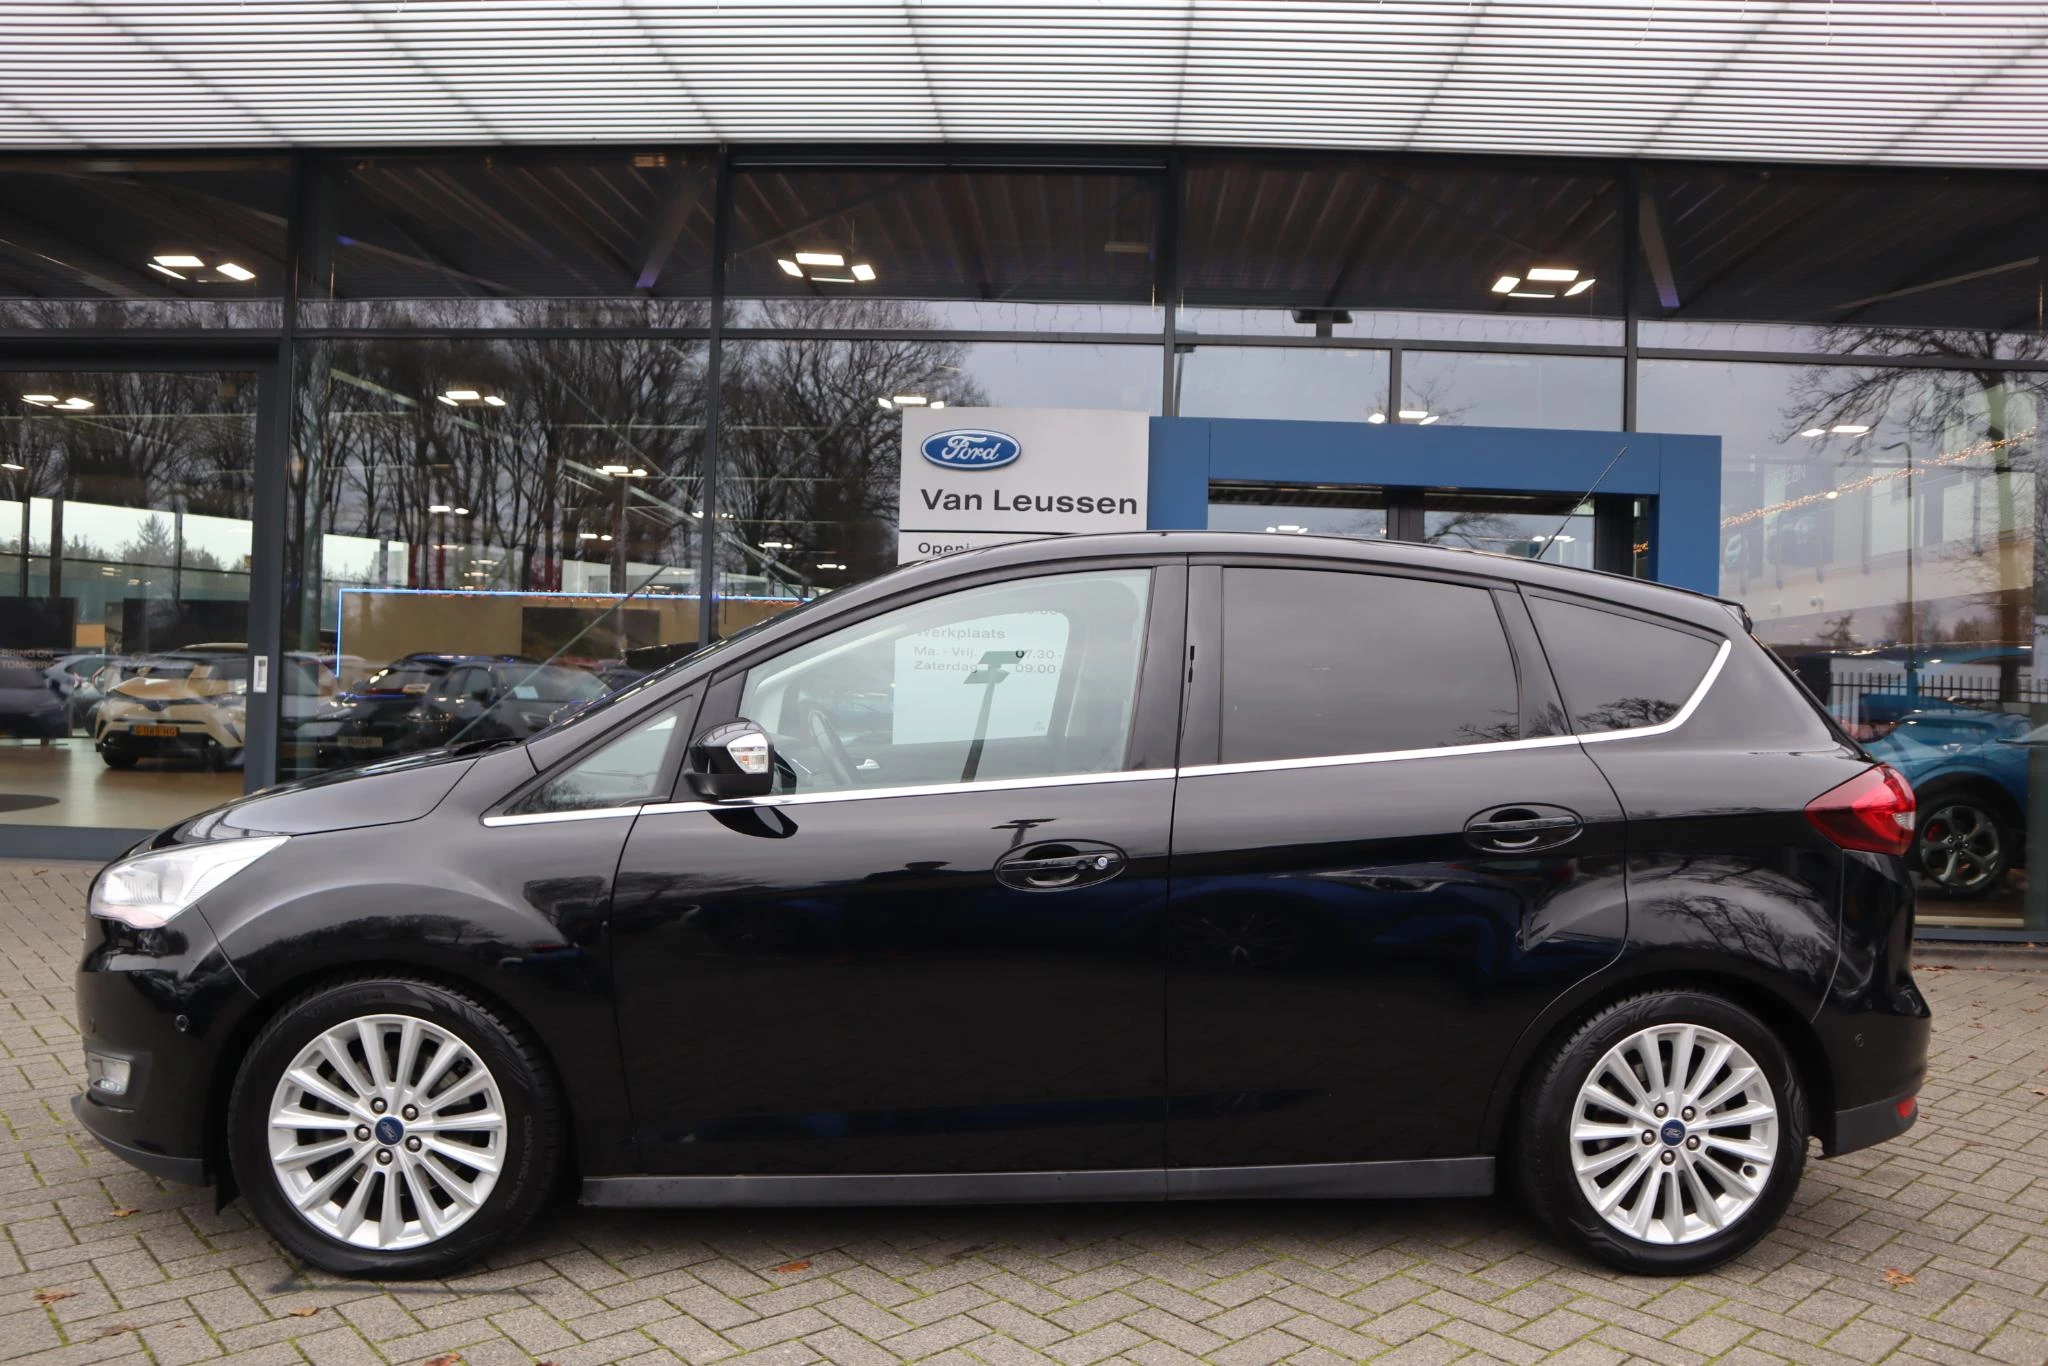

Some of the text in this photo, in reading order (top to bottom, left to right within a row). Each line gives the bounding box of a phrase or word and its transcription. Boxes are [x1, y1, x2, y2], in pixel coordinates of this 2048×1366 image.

[942, 435, 1001, 460] Ford
[921, 489, 1137, 514] Van Leussen
[913, 646, 940, 657] Ma.
[1015, 650, 1055, 660] 07.30
[913, 660, 1056, 674] Zaterdag 09.00
